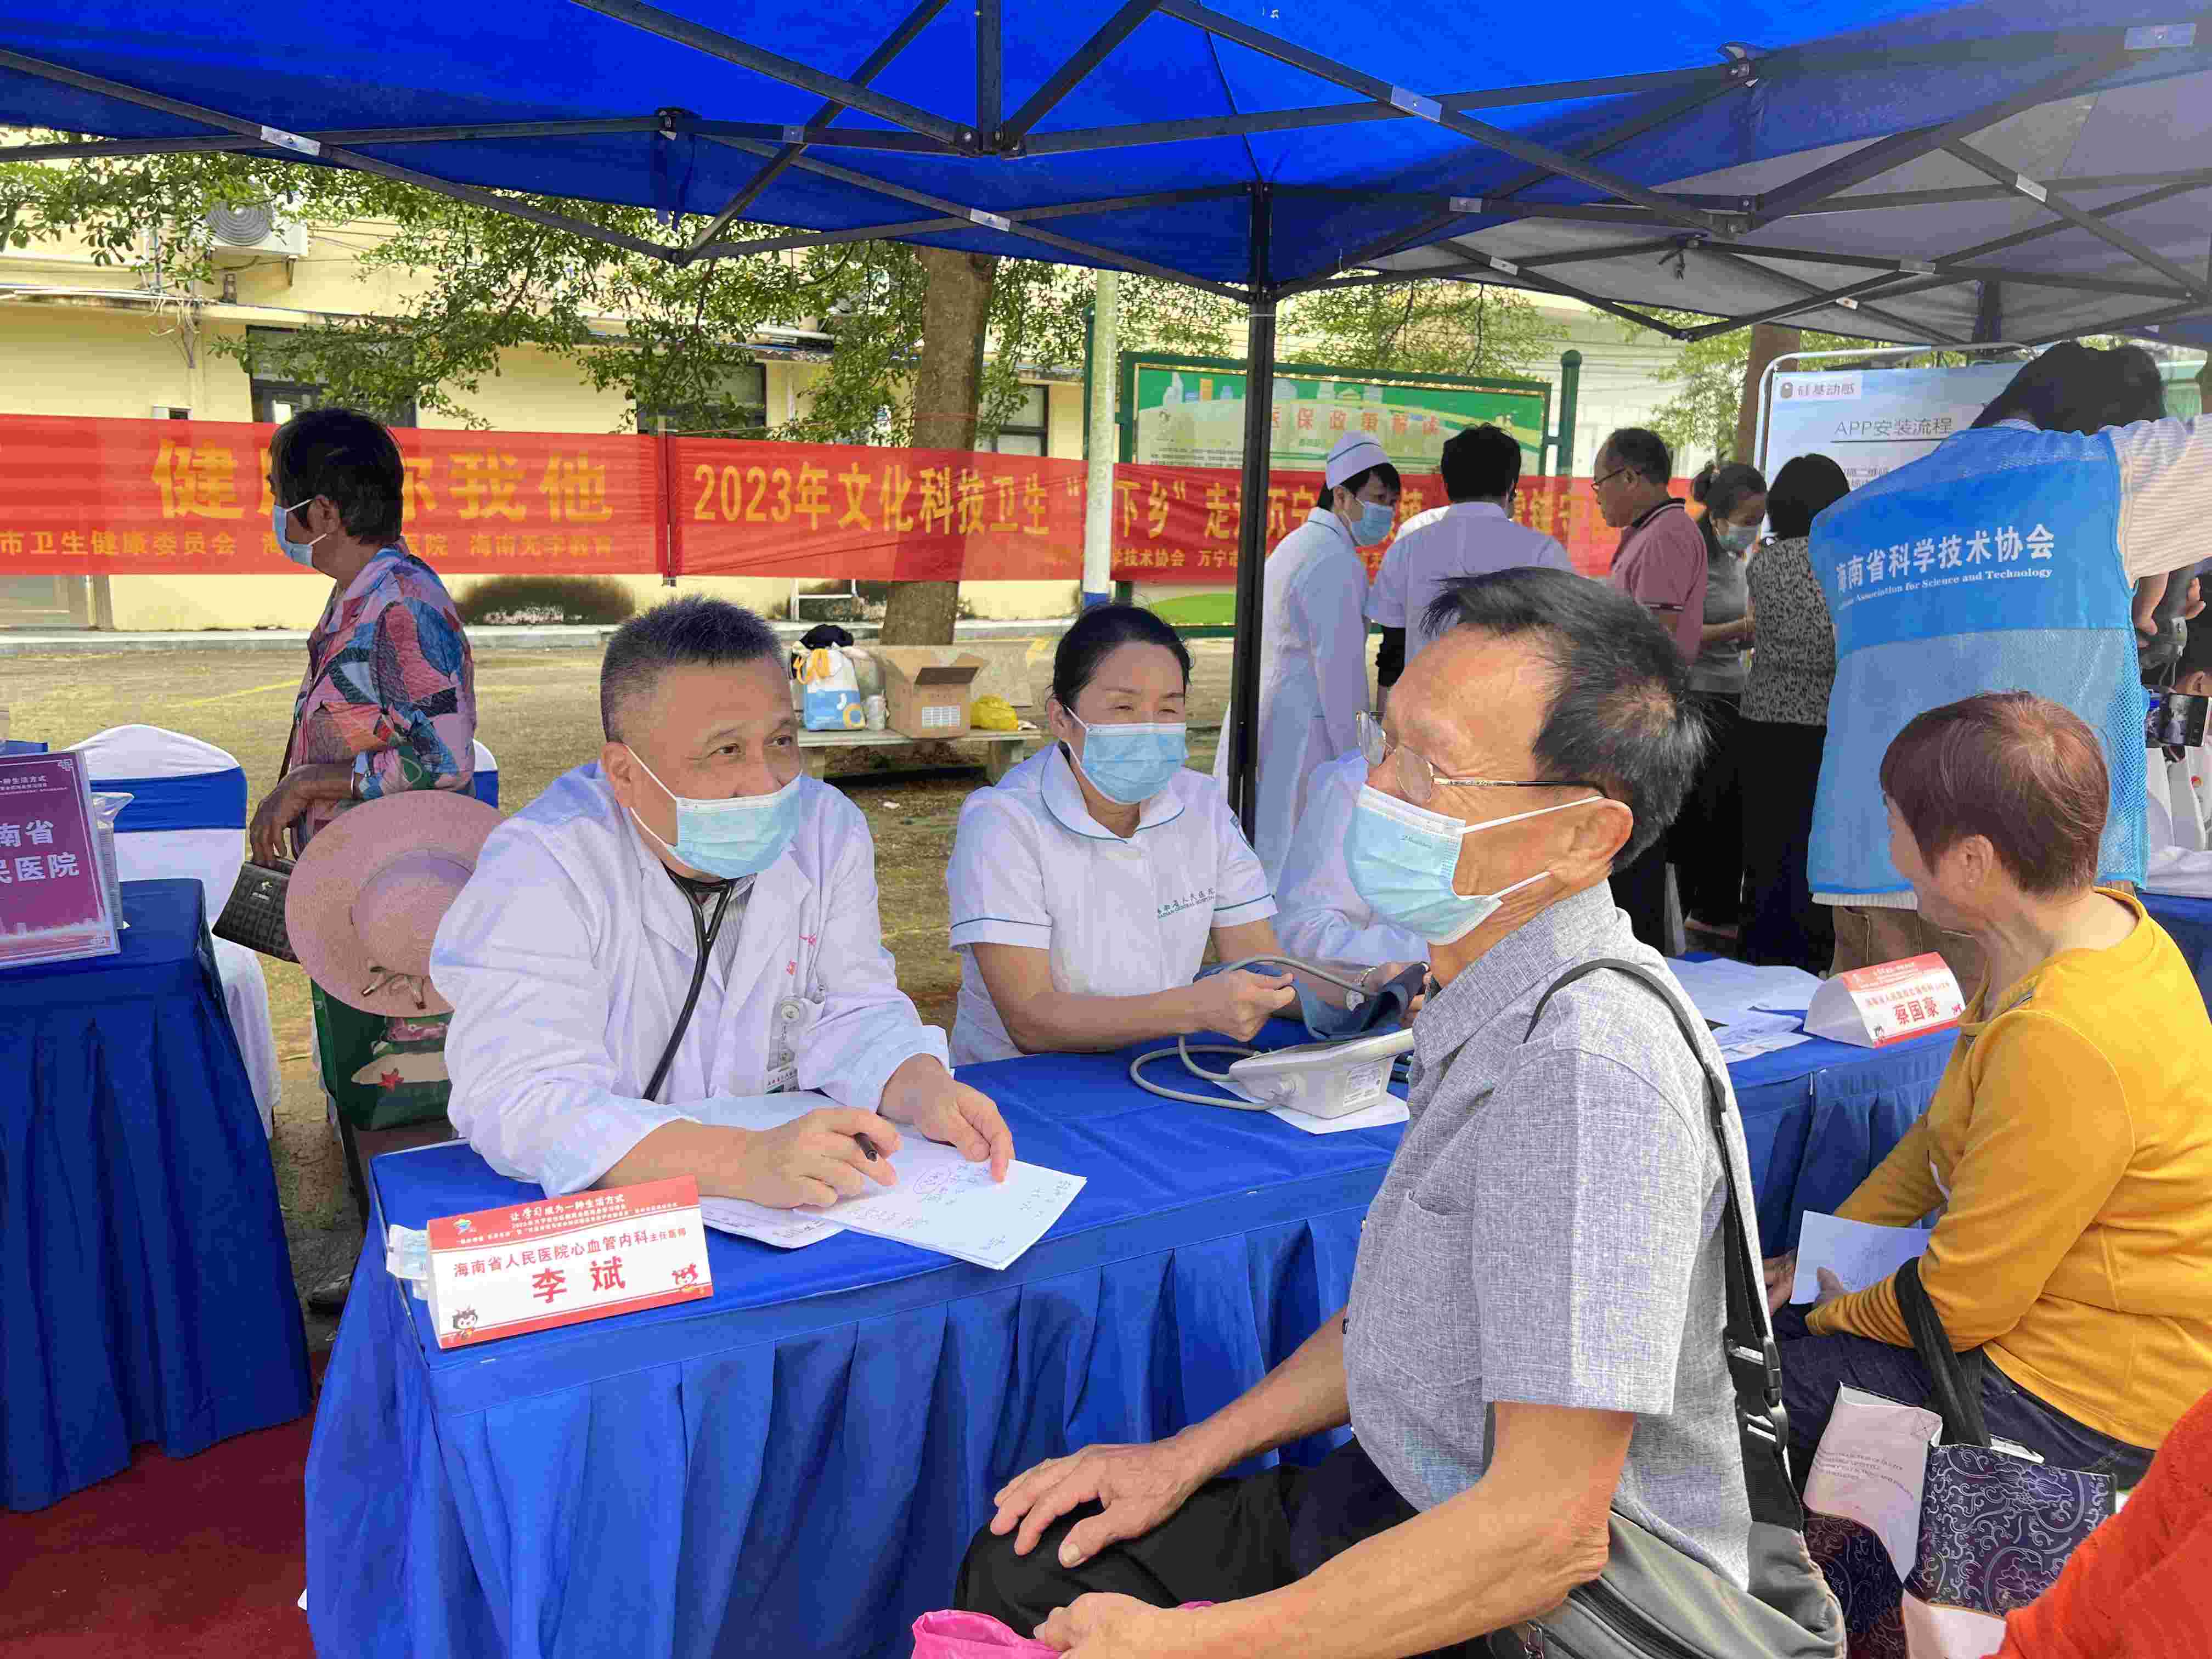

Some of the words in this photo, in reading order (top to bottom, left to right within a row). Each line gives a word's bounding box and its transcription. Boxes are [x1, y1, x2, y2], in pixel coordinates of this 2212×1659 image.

[1834, 417, 1953, 436] APP安装流程
[1905, 581, 1921, 591] for
[1922, 575, 1960, 589] Science
[1962, 571, 1982, 583] and
[1984, 568, 2053, 580] Technology
